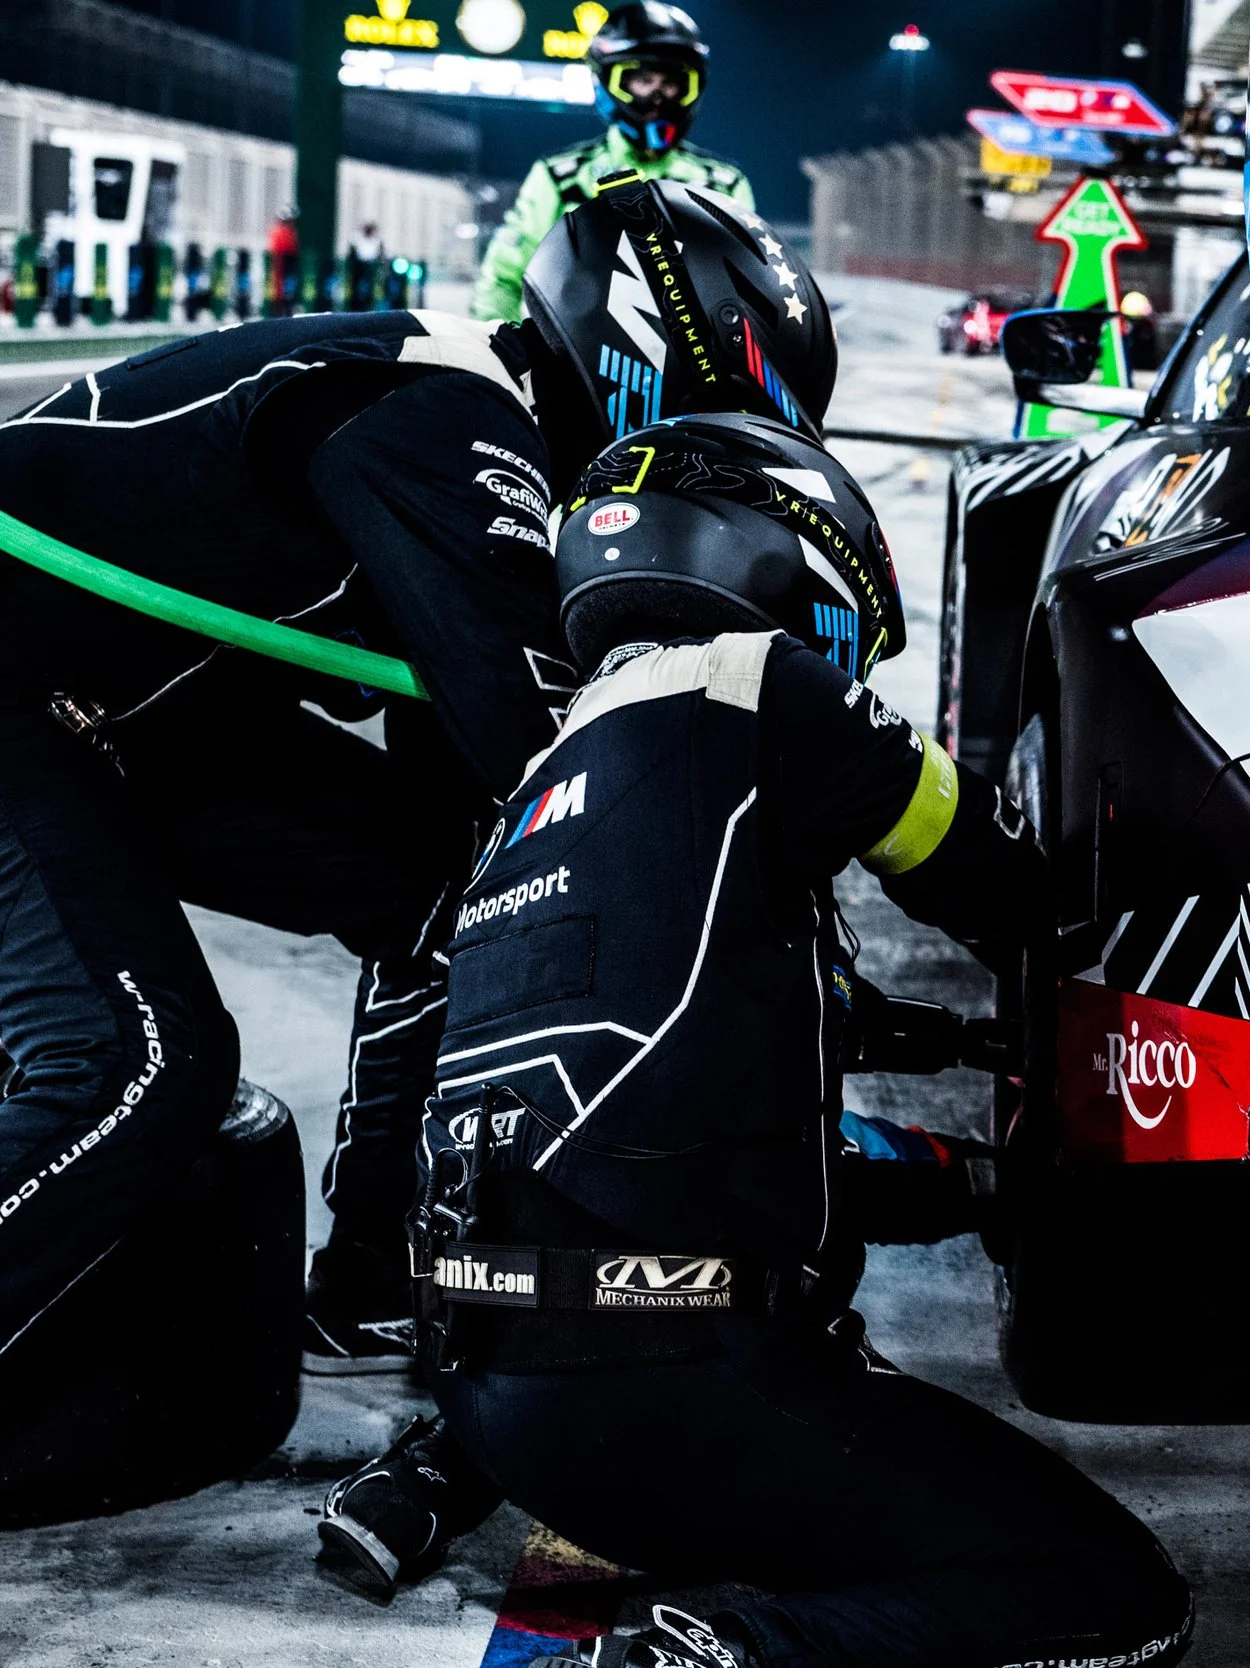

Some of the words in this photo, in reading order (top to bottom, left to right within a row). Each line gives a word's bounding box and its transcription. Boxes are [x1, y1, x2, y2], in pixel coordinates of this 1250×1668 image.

[471, 440, 551, 504] SKECHE
[486, 516, 550, 551] Snap
[594, 510, 631, 527] BELL
[454, 866, 571, 939] Motorsport
[0, 970, 165, 1225] w-racingteam.co
[595, 1288, 685, 1307] MECHANIX
[687, 1288, 731, 1308] WEAR
